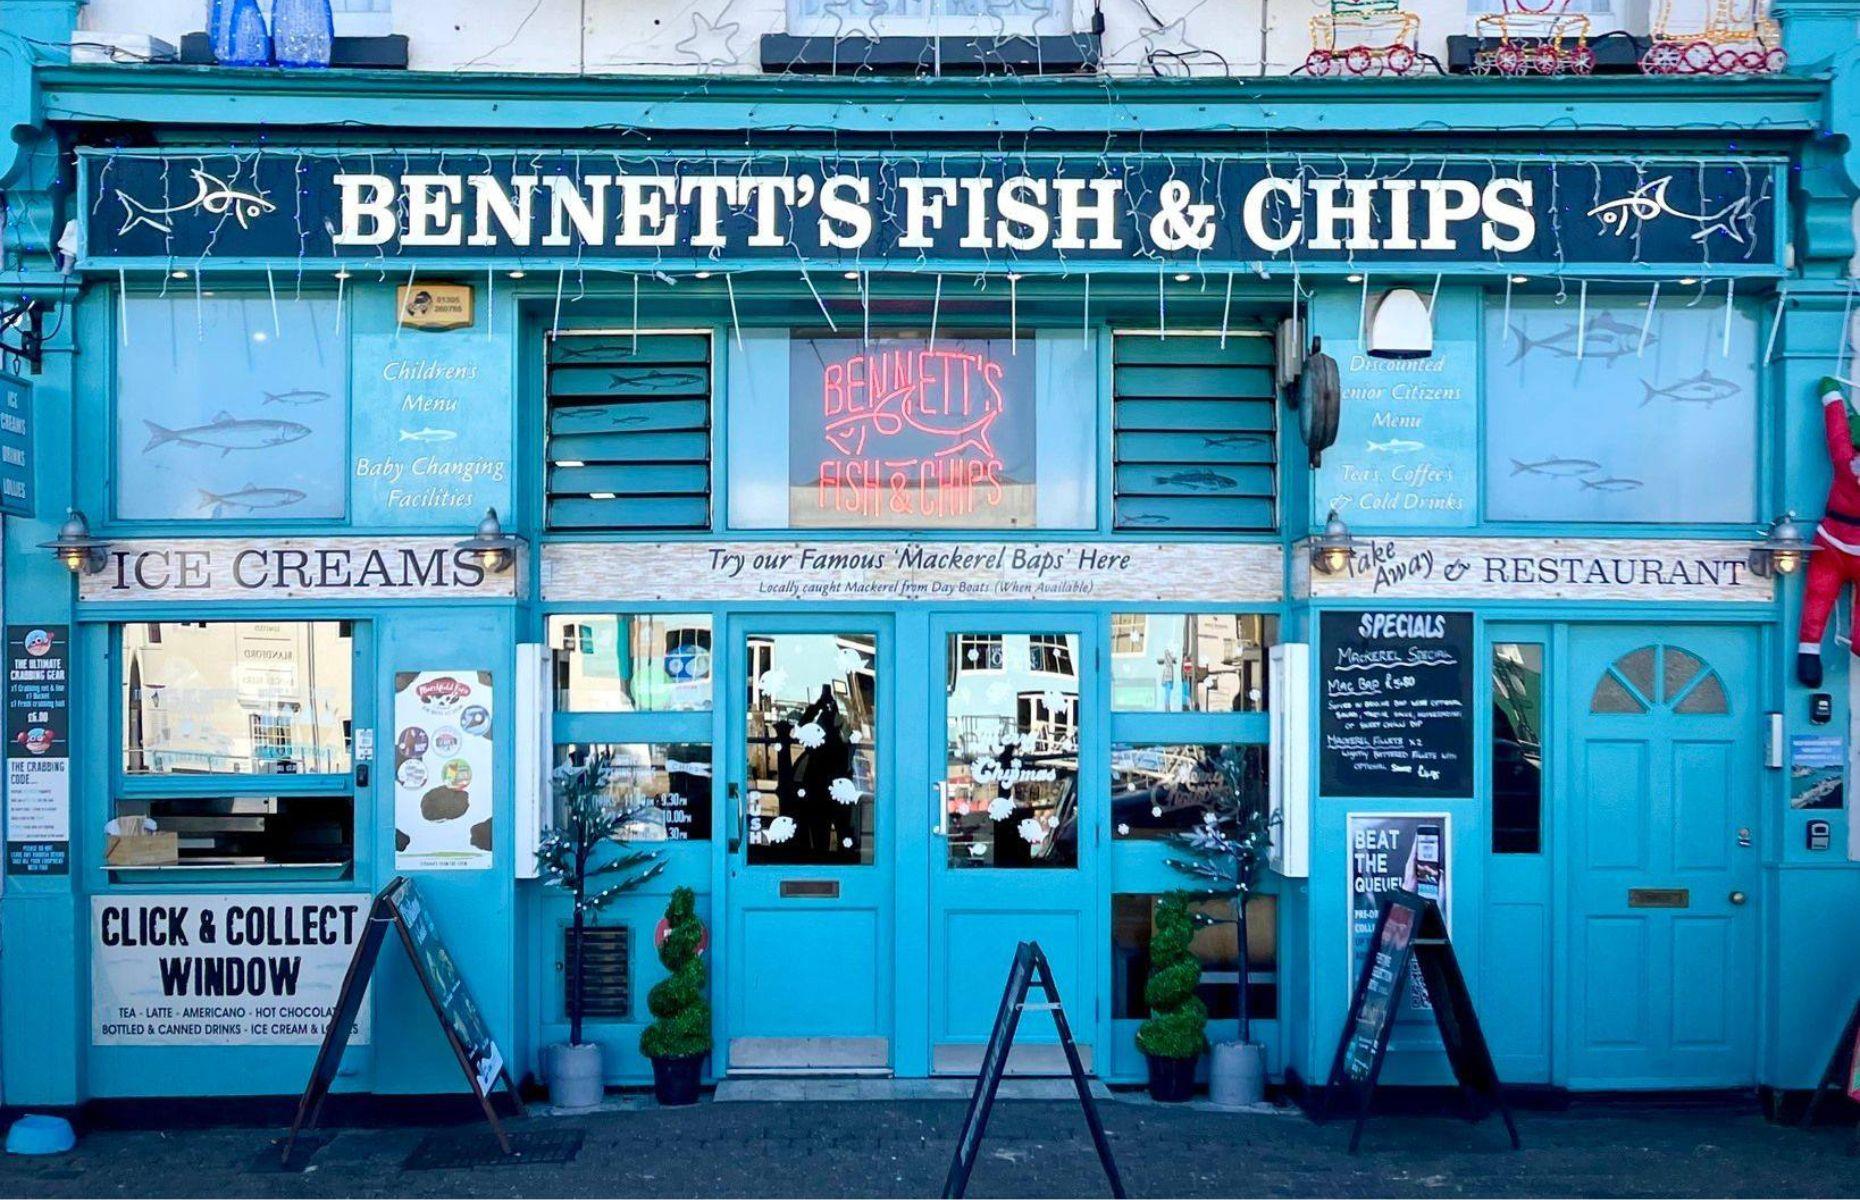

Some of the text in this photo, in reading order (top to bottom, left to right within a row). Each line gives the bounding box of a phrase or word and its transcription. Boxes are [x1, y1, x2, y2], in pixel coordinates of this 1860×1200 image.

[333, 174, 1536, 252] BENNETT'S FISH & CHIPS
[1350, 355, 1446, 373] Discounted
[824, 351, 1004, 416] BENNETT'S
[1341, 383, 1461, 401] enior Citizens
[402, 394, 458, 412] Menu
[1371, 411, 1423, 429] Menu
[356, 455, 504, 481] Baby Changing
[387, 487, 473, 508] Facilities
[820, 460, 1003, 517] FISH & CHIPS
[1330, 492, 1464, 511] & Cold Drinks
[112, 549, 485, 590] ICE CREAMS
[708, 549, 745, 577] Try
[752, 553, 793, 570] our
[800, 549, 885, 570] Famous
[1078, 549, 1131, 570] Here
[1348, 541, 1396, 578] Take
[1373, 549, 1746, 594] Away & RESTAURANT
[758, 580, 1094, 596] Locally caught Mackerel from Day Boats (When Available)
[1358, 613, 1446, 639] SPECIALS
[15, 659, 28, 669] THE
[46, 670, 65, 680] GEAR
[11, 761, 65, 772] THE CRABBING
[1355, 829, 1400, 850] BEAT
[1355, 853, 1388, 873] THE
[102, 907, 188, 946] CLICK
[200, 909, 216, 943] &
[226, 905, 358, 945] COLLECT
[159, 957, 301, 996] WINDOW
[119, 1007, 136, 1018] TEA
[146, 1007, 173, 1018] LATTE
[183, 1007, 246, 1018] AMERICANO
[256, 1007, 276, 1018] HOT
[279, 1007, 337, 1018] CHOCOLAT
[102, 1024, 144, 1035] BOTTLED
[148, 1024, 155, 1035] &
[158, 1024, 202, 1035] CANNED
[204, 1024, 241, 1035] DRINKS
[251, 1024, 268, 1034] ICE
[271, 1023, 308, 1034] CREAM
[311, 1023, 318, 1034] &
